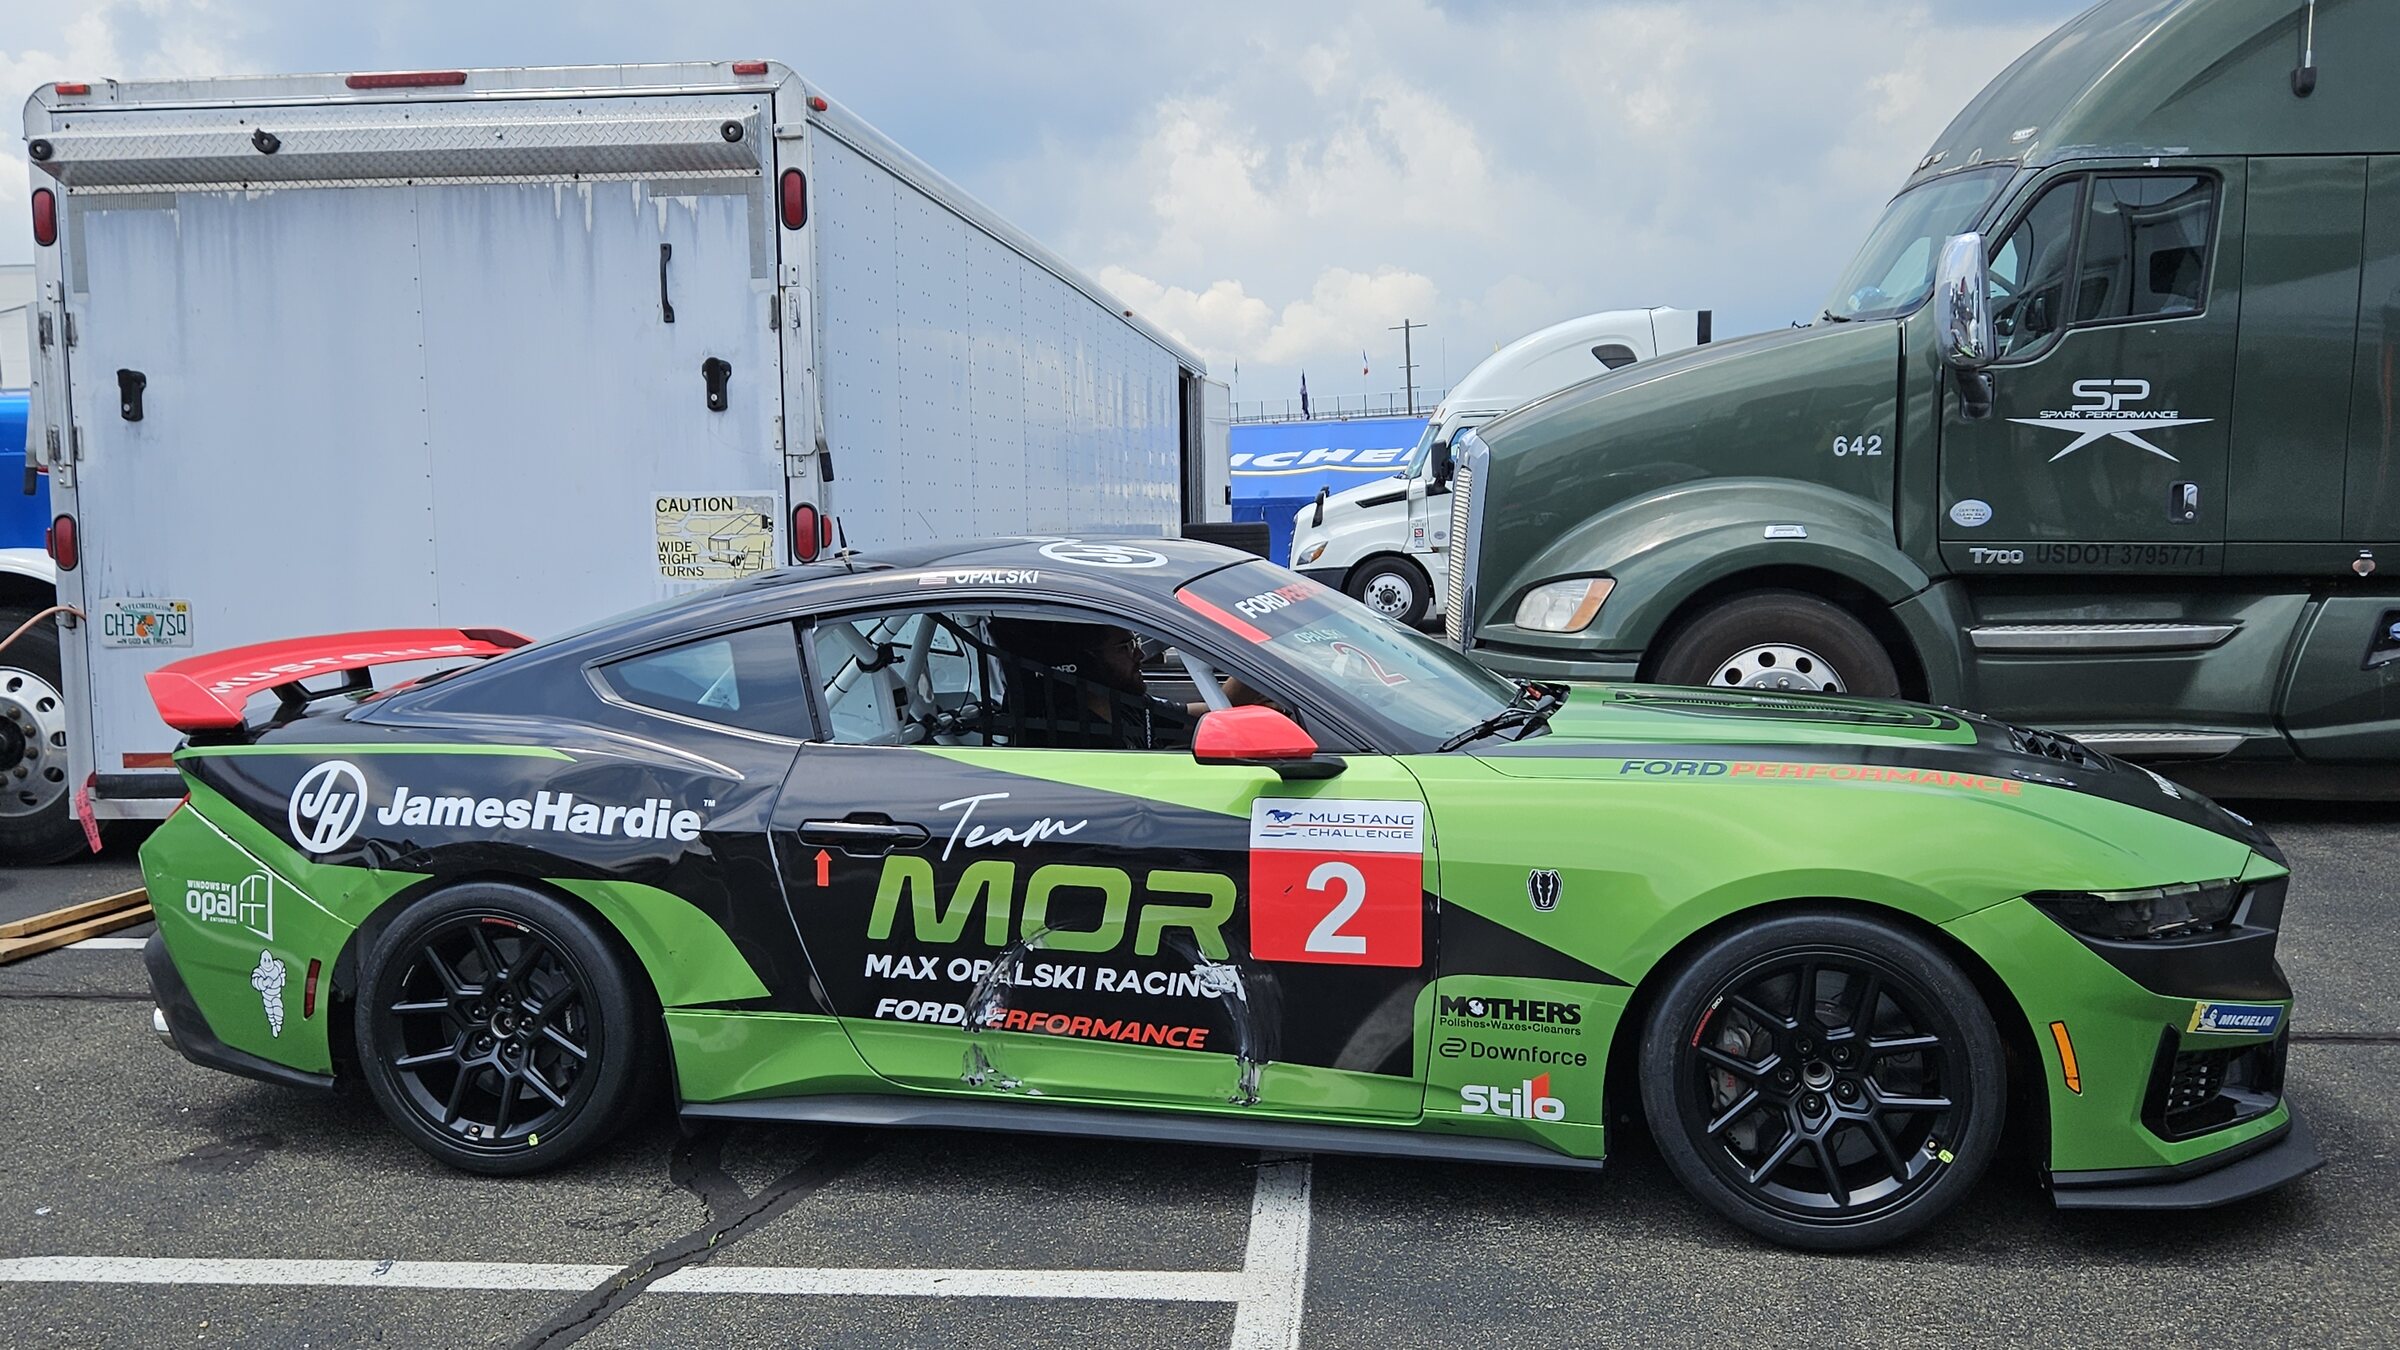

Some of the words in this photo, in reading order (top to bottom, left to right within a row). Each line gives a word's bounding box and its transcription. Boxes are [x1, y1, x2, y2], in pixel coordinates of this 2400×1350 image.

[2072, 379, 2150, 411] SP
[2039, 410, 2081, 419] SPARK
[2085, 410, 2178, 419] PERFORMANCE
[1833, 434, 1882, 457] 642
[1231, 447, 1417, 467] ICHE
[656, 497, 733, 512] CAUTION
[658, 541, 693, 553] WIDE
[1969, 547, 2024, 565] T700
[2036, 545, 2115, 566] USDOT
[2120, 544, 2206, 566] 3795771
[658, 553, 698, 565] RIGHT
[661, 566, 704, 577] TURNS
[954, 570, 1040, 584] OPALSKI
[104, 613, 135, 637] CH3
[155, 613, 187, 637] 7SQ
[376, 786, 702, 842] JamesHardie
[1309, 813, 1414, 826] MUSTANG
[938, 792, 1088, 861] Team
[1308, 829, 1414, 839] CHALLENGE
[186, 880, 221, 891] WINDOWS
[221, 882, 231, 892] BY
[186, 885, 237, 921] opal
[867, 855, 1237, 960] MOR
[1305, 861, 1367, 955] 2
[864, 953, 939, 981] MAX
[947, 958, 1086, 989] OPLSKI
[1440, 995, 1582, 1025] MOTHERS
[2217, 1014, 2275, 1027] MICHELIN
[1471, 1041, 1588, 1067] Downforce
[1460, 1075, 1566, 1121] Stilo
